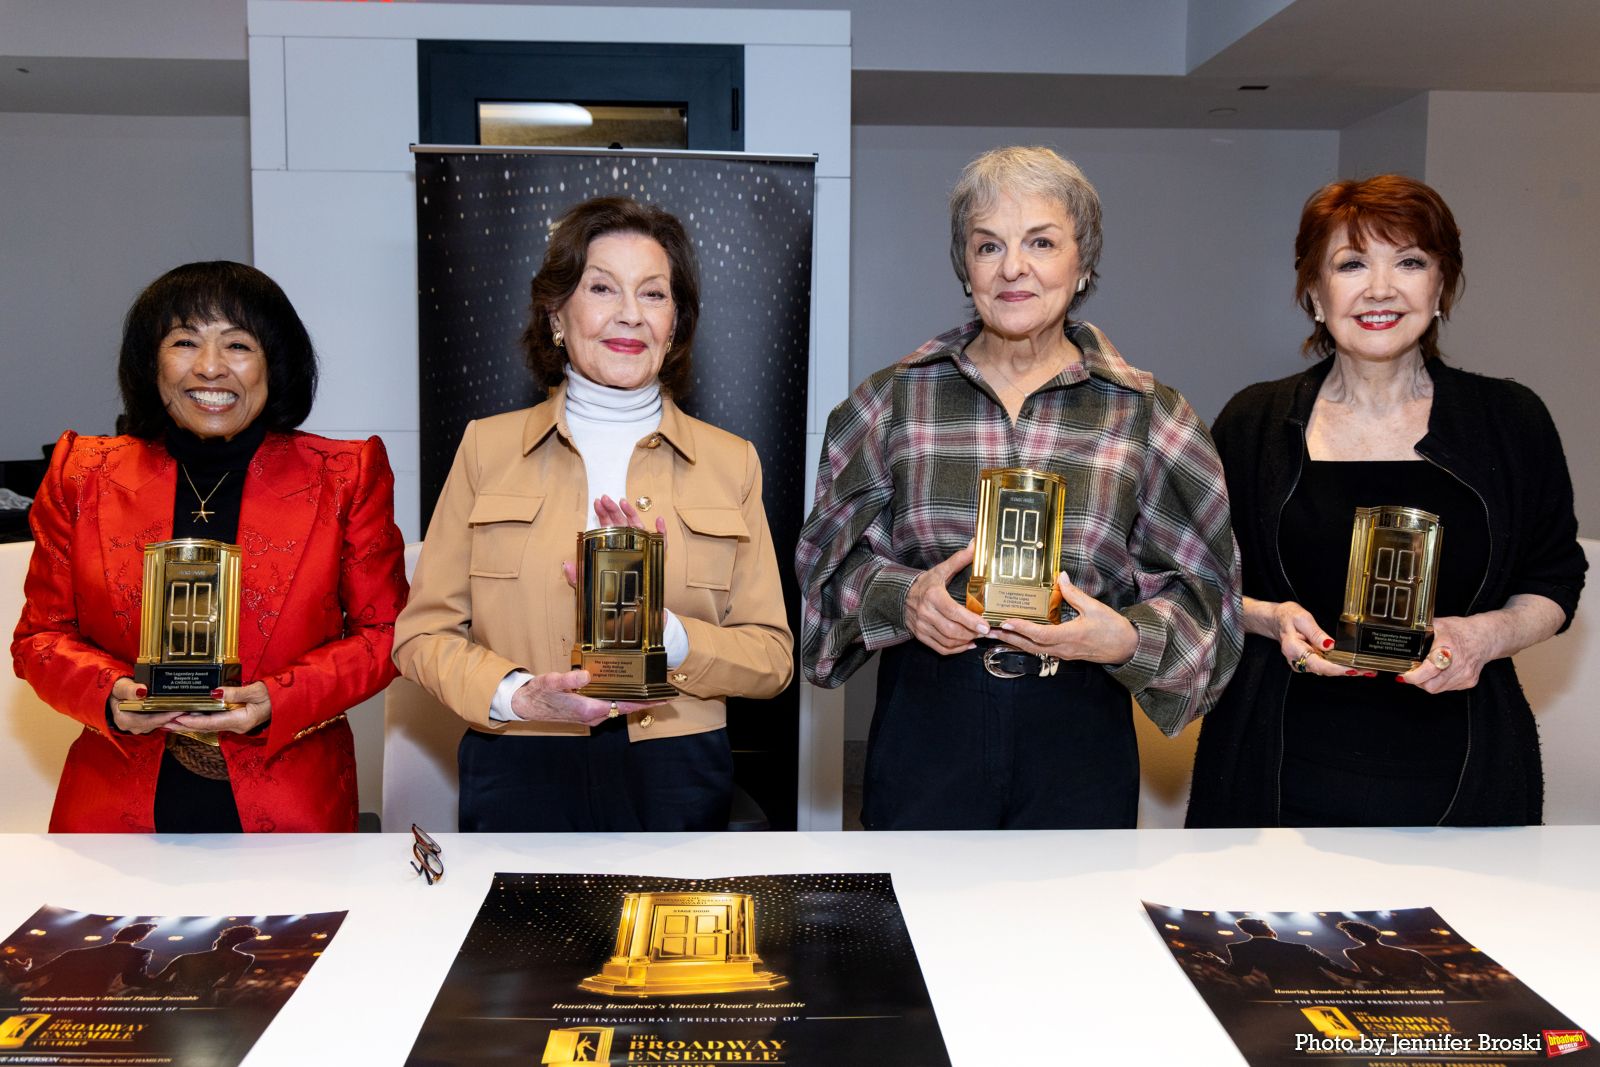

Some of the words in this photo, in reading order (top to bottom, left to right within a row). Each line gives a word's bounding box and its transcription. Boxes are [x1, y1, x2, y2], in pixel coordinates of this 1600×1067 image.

[605, 1002, 666, 1010] Broadway's
[755, 1001, 806, 1009] Ensemble
[48, 1023, 148, 1031] BROADWAY
[40, 1031, 135, 1040] ENSEMBLE
[630, 1040, 786, 1050] BROADWAY
[628, 1051, 779, 1061] ENSEMBLE
